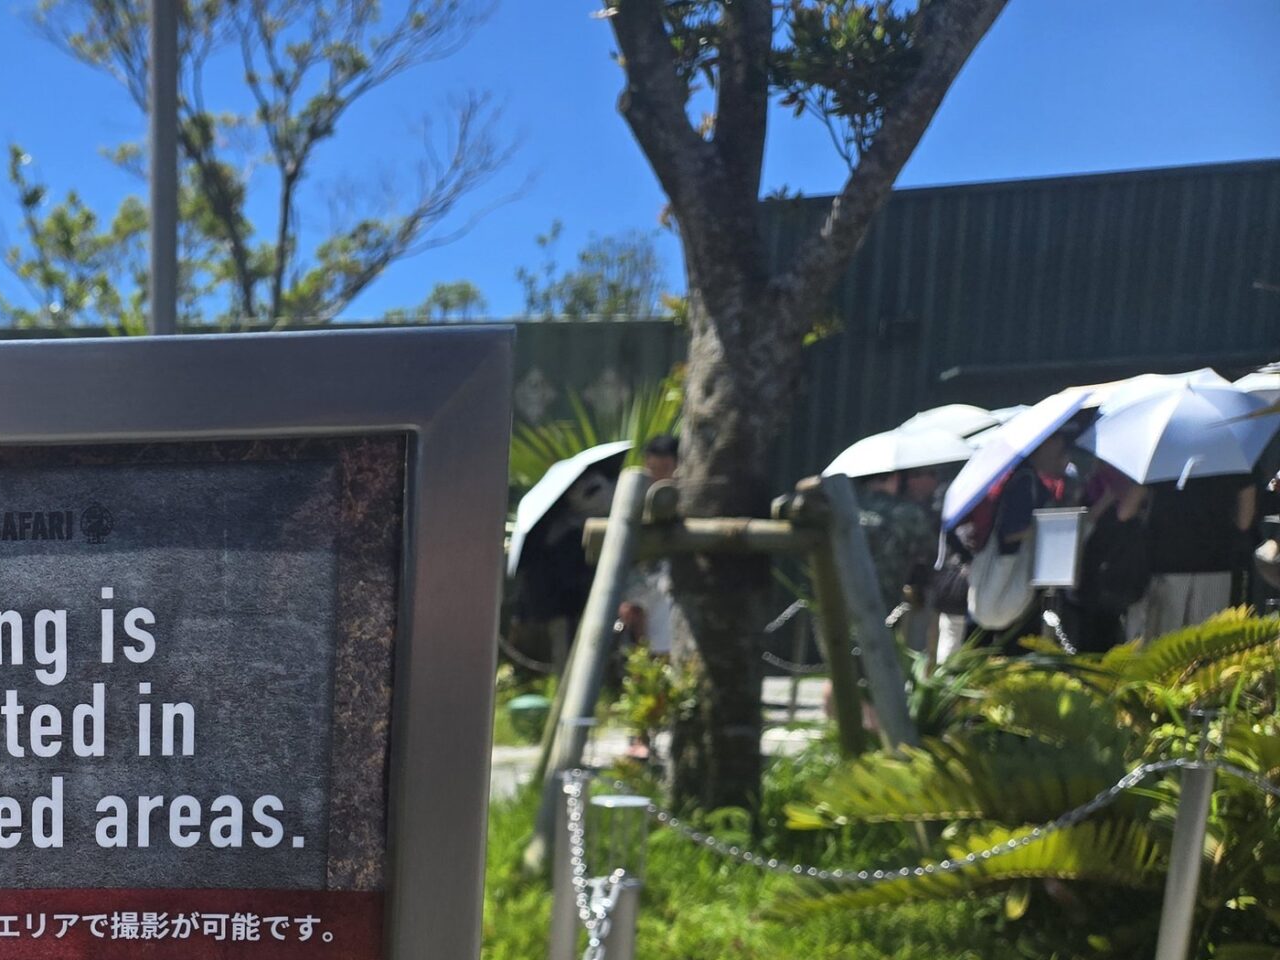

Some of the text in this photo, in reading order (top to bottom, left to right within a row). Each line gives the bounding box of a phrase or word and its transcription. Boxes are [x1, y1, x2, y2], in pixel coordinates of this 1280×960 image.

[100, 586, 156, 664] is
[138, 682, 195, 757] in
[95, 796, 305, 848] areas.
